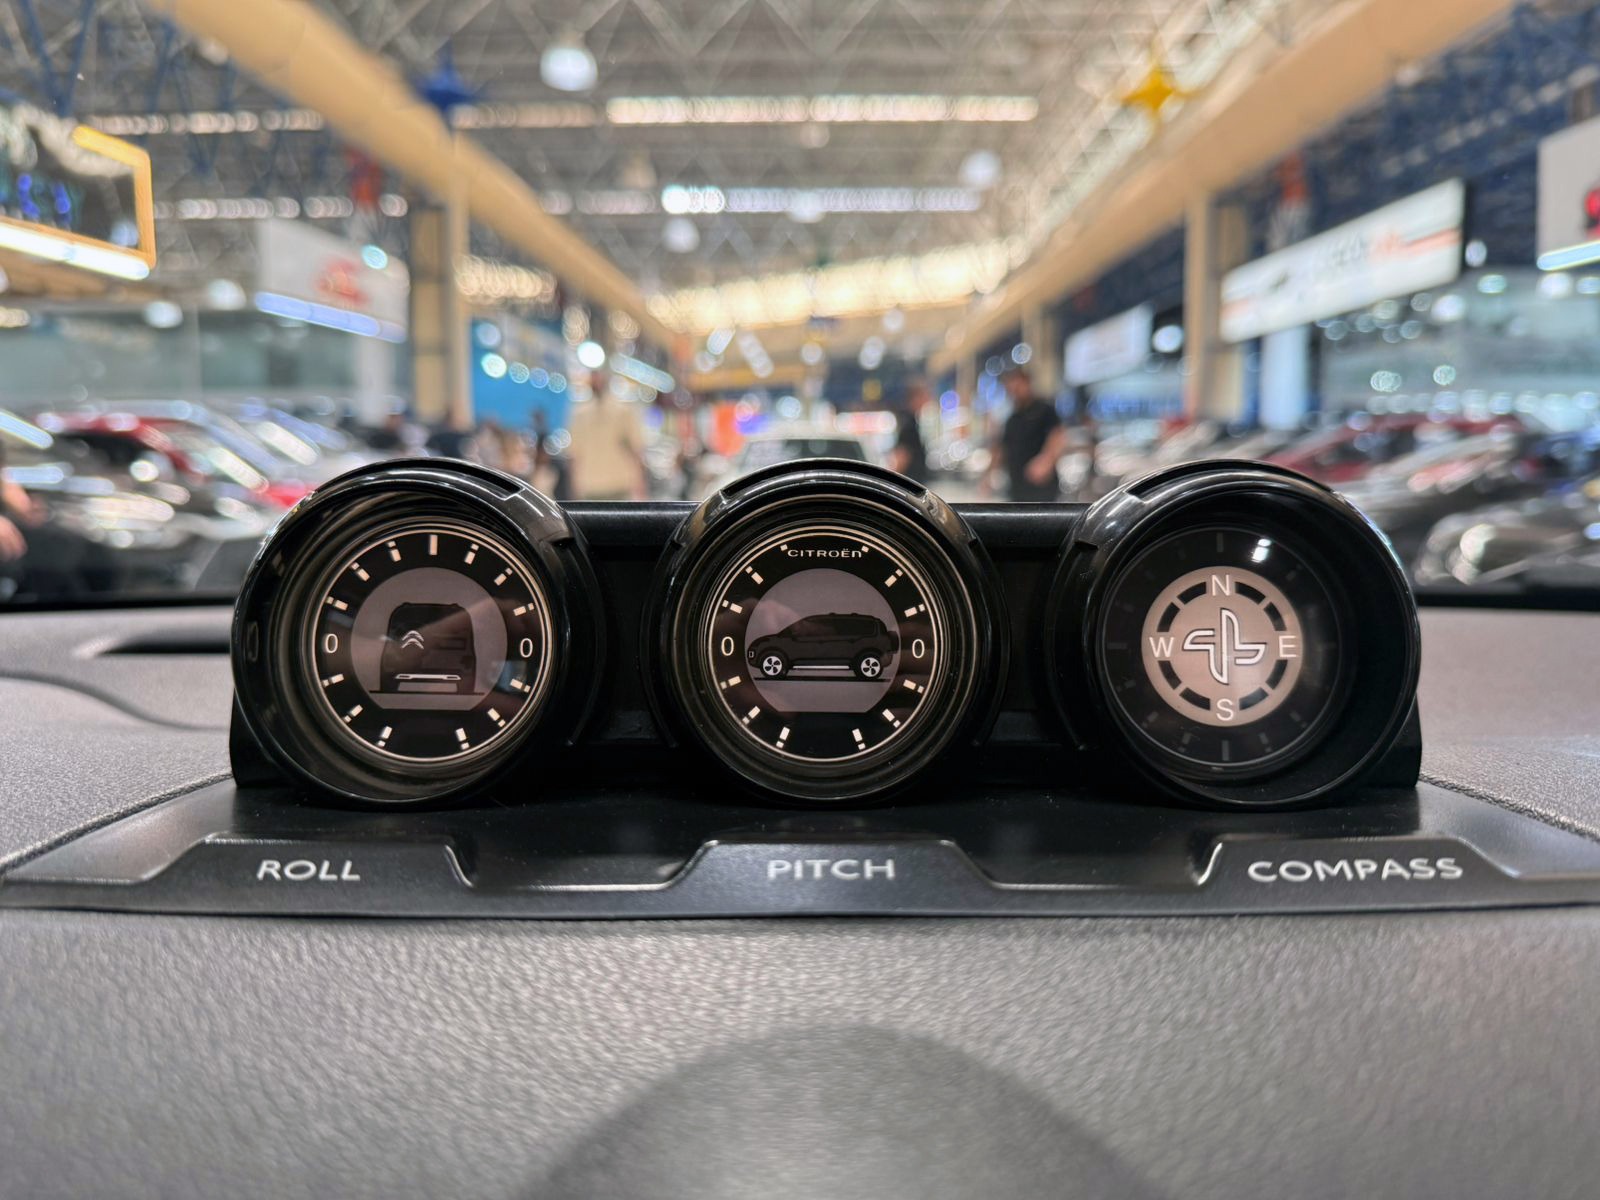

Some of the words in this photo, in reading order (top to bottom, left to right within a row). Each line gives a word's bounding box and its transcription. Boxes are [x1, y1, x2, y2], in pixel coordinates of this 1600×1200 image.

[1211, 574, 1231, 597] N
[325, 633, 338, 653] 0
[520, 638, 533, 658] 0
[721, 636, 734, 656] 0
[912, 639, 925, 659] 0
[1148, 636, 1176, 658] W
[1277, 635, 1298, 659] E
[1215, 698, 1236, 722] S
[256, 859, 361, 881] ROLL
[767, 859, 896, 880] PITCH
[1248, 857, 1463, 882] COMPASS
